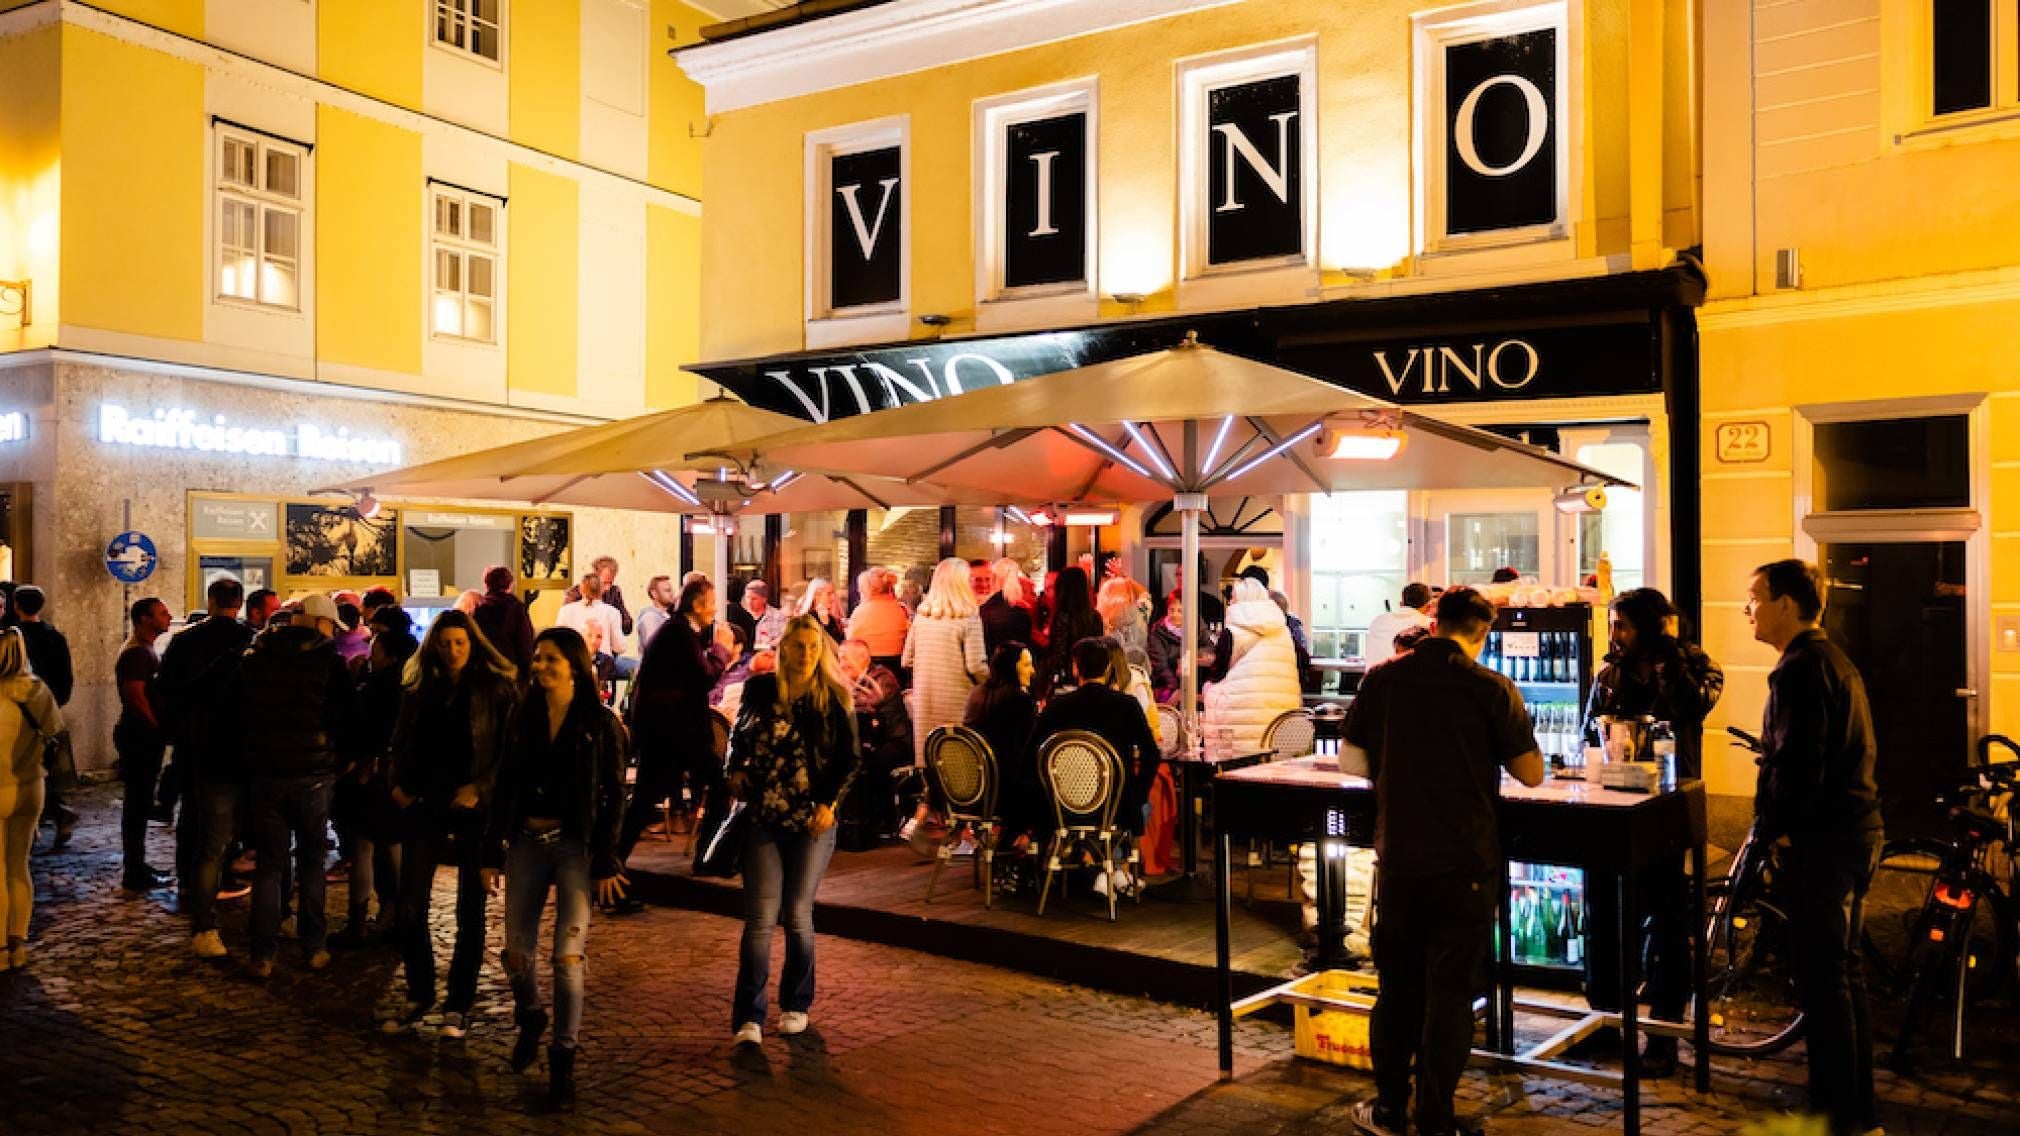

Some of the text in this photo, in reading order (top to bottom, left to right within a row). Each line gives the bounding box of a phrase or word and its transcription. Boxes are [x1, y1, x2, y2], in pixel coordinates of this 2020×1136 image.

[764, 352, 1015, 425] VINO
[1373, 339, 1540, 396] VINO
[99, 404, 288, 456] Raiffeisen
[1728, 425, 1759, 449] 22
